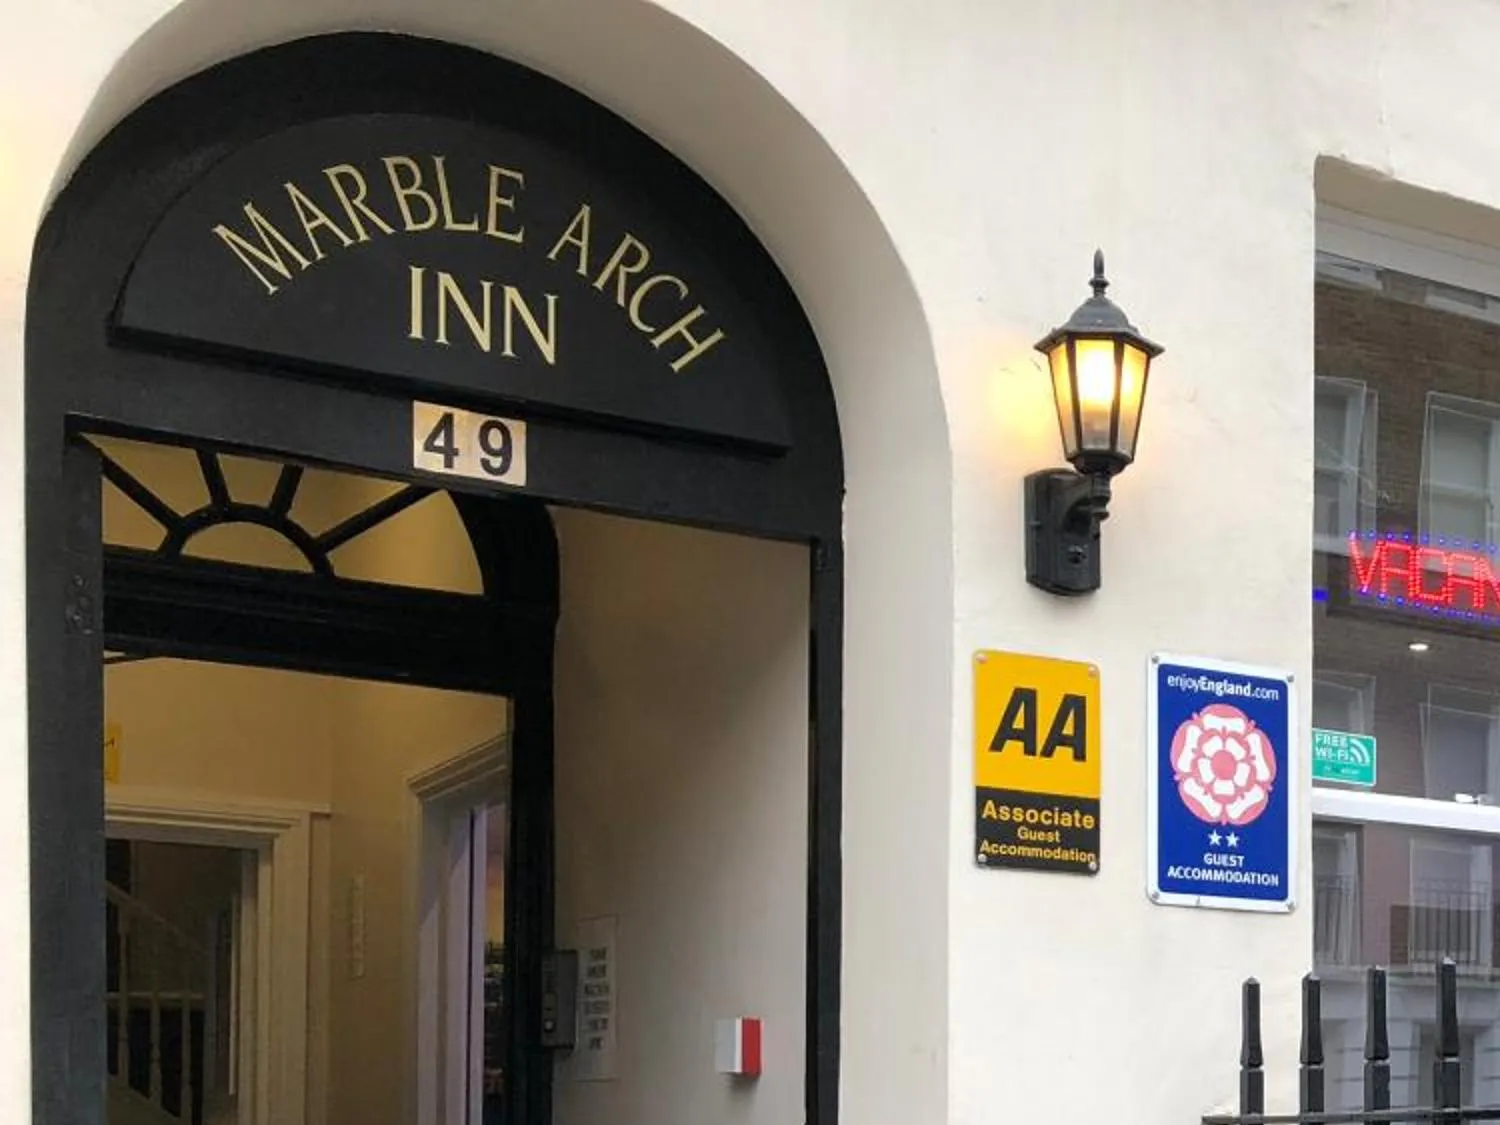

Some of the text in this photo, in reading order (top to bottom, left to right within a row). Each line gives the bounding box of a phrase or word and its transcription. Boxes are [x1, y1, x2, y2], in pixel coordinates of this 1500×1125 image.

[212, 155, 725, 373] MARBLE ARCH
[408, 265, 559, 366] INN
[422, 412, 515, 478] 49
[1166, 674, 1280, 701] enjoyEngland.com
[988, 686, 1087, 763] AA
[1315, 733, 1348, 748] FREE
[982, 799, 1096, 830] Associate
[1016, 825, 1061, 844] Guest
[979, 839, 1097, 864] Accommodation
[1203, 852, 1245, 868] GUEST
[1166, 865, 1280, 887] ACCOMMODATION
